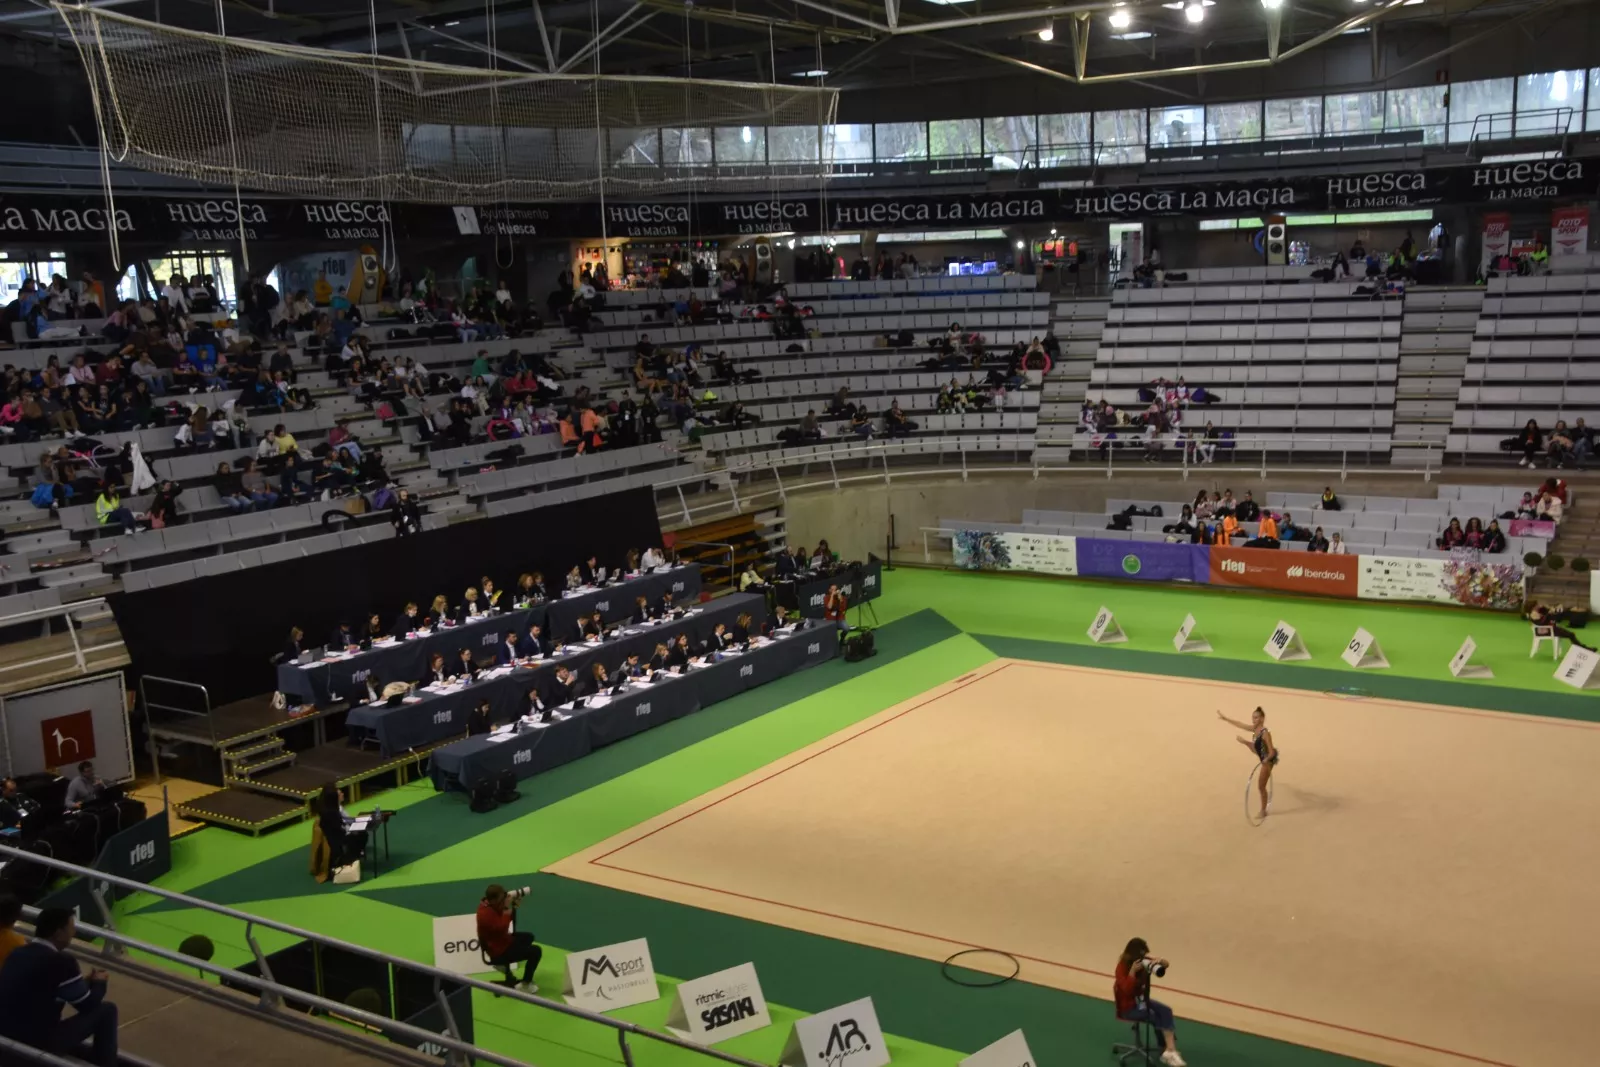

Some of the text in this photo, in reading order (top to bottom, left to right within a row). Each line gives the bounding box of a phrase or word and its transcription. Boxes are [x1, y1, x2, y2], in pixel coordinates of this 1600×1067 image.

[498, 222, 536, 235] Huesca
[1304, 568, 1345, 580] Iberdrola
[130, 840, 155, 865] rfeg
